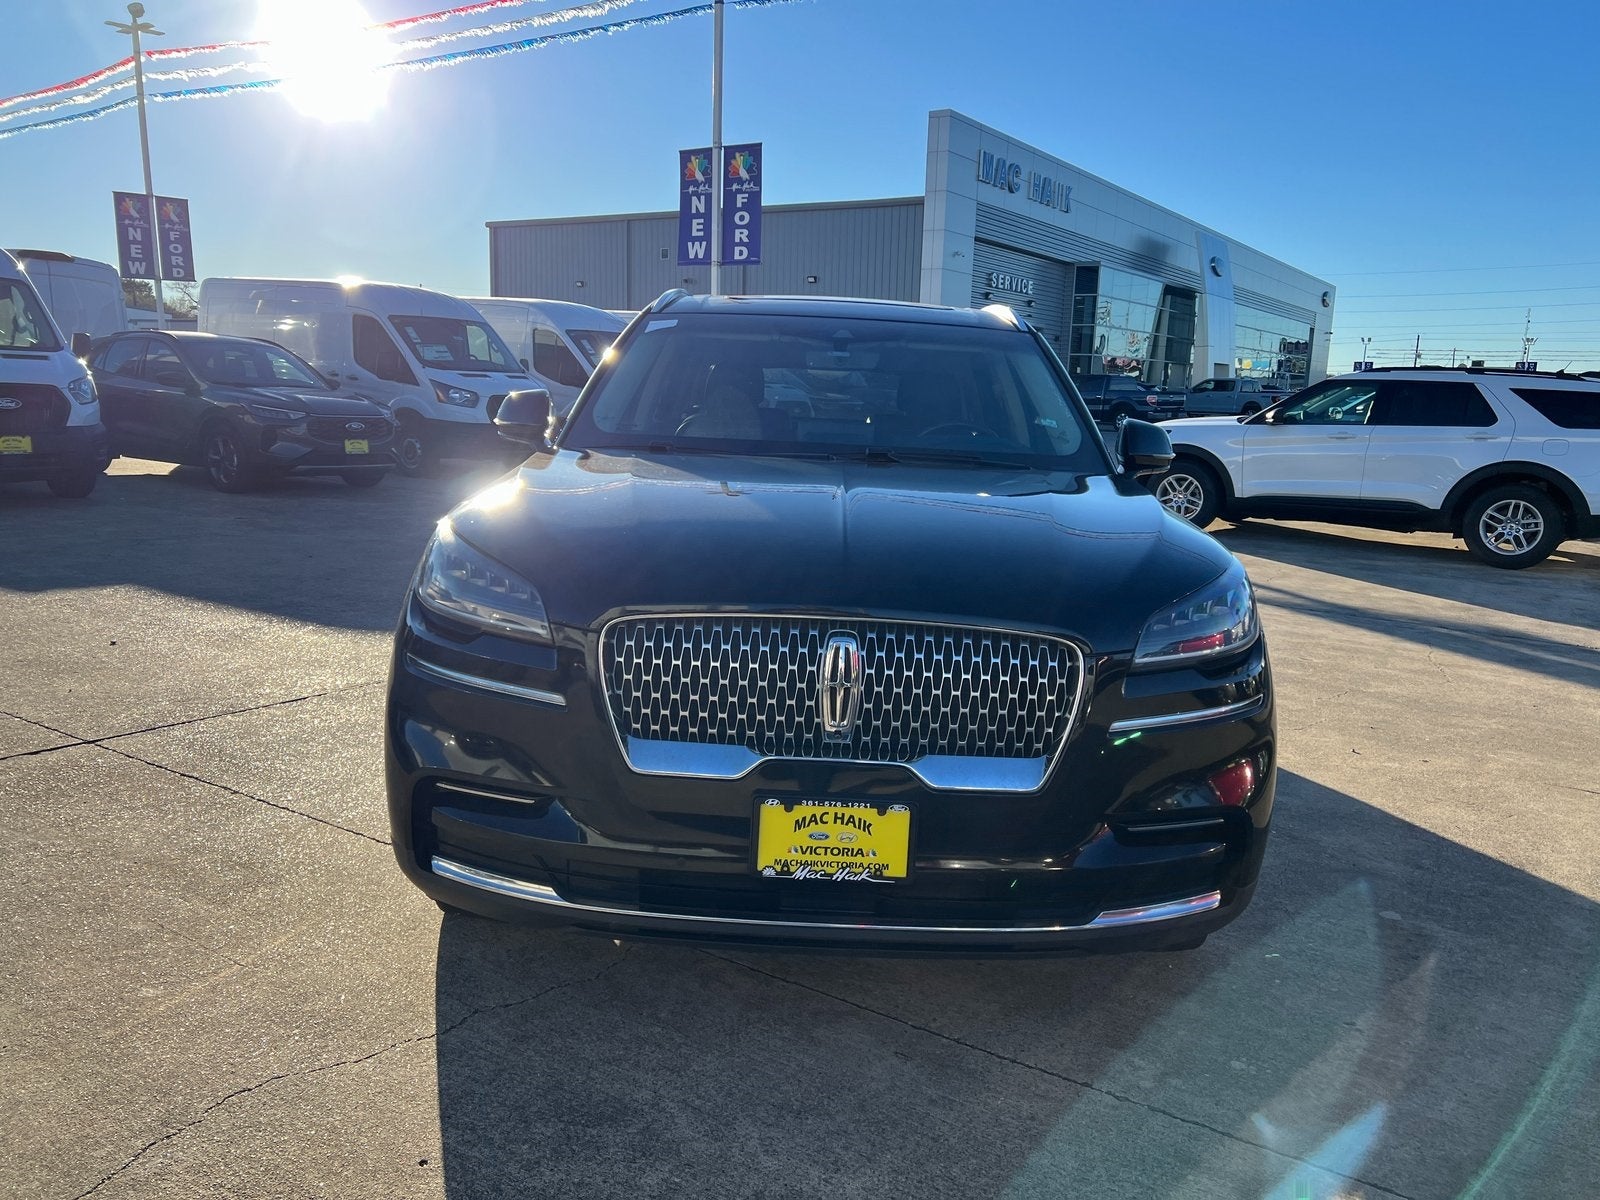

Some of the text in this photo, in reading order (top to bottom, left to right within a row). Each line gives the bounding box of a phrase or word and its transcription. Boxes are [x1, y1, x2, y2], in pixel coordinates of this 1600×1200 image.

[978, 149, 1073, 213] MAC HAIK
[687, 195, 707, 259] NEW
[734, 193, 750, 260] FORD
[128, 227, 146, 275] NEW
[169, 231, 185, 278] FORD
[991, 272, 1034, 295] SERVICE
[793, 811, 872, 836] MAC HAIK
[791, 866, 875, 882] Mac Haik
[799, 846, 865, 857] VICTORIA
